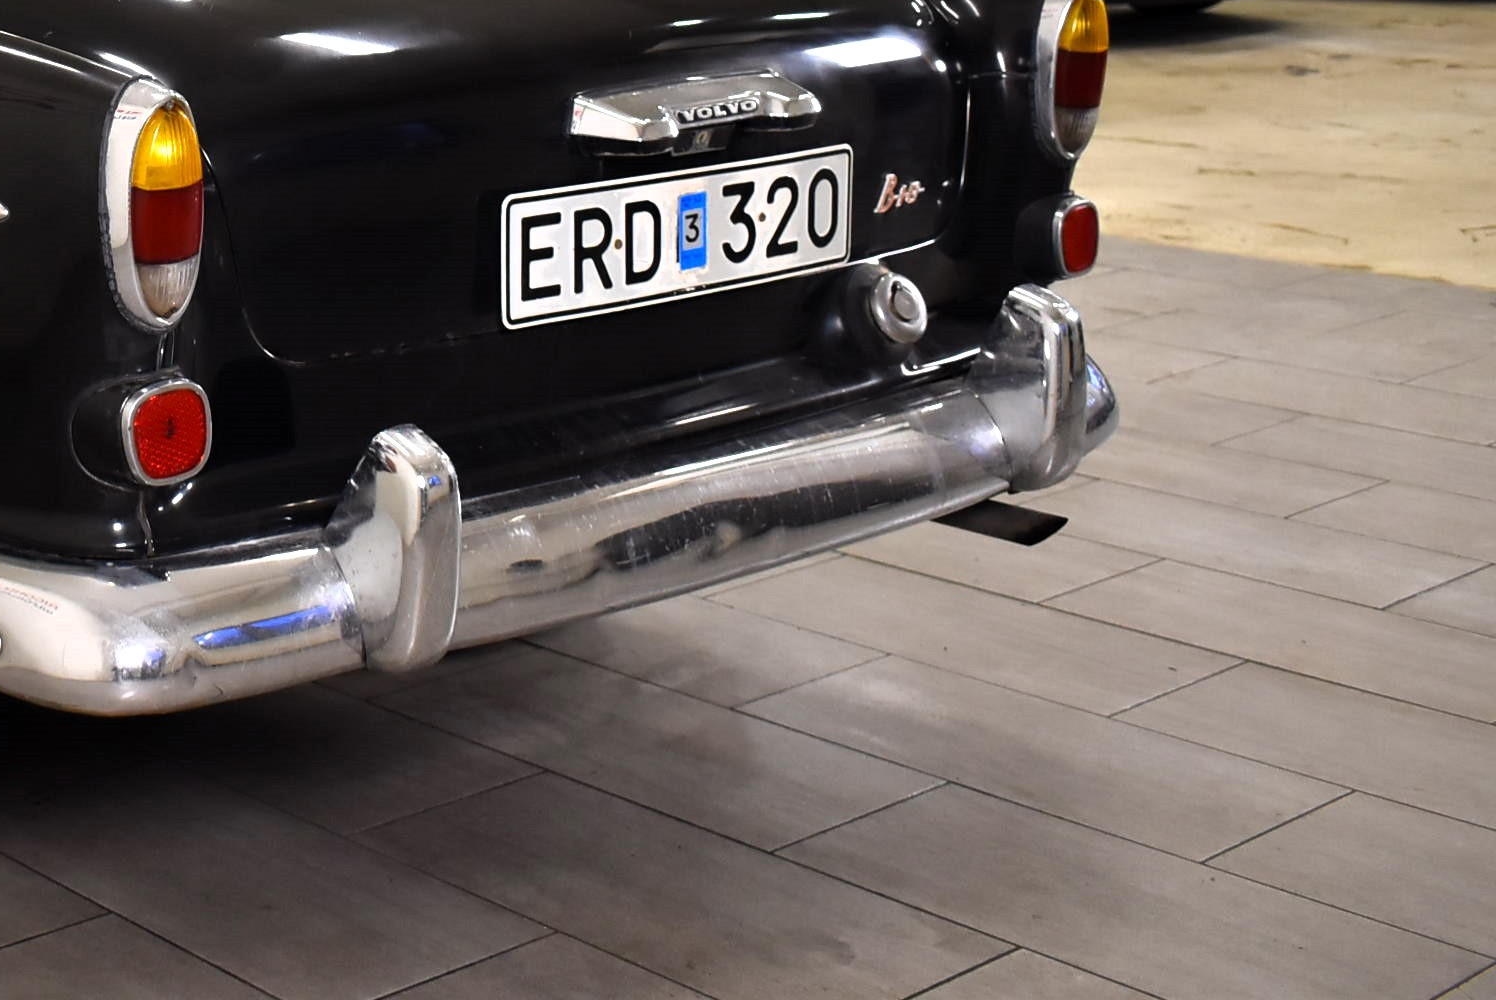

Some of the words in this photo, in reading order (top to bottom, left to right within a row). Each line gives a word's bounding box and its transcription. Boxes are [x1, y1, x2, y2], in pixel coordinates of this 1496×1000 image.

[683, 100, 757, 121] VOLVO
[521, 200, 662, 302] ERD
[685, 213, 699, 243] 3
[722, 168, 840, 264] 320
